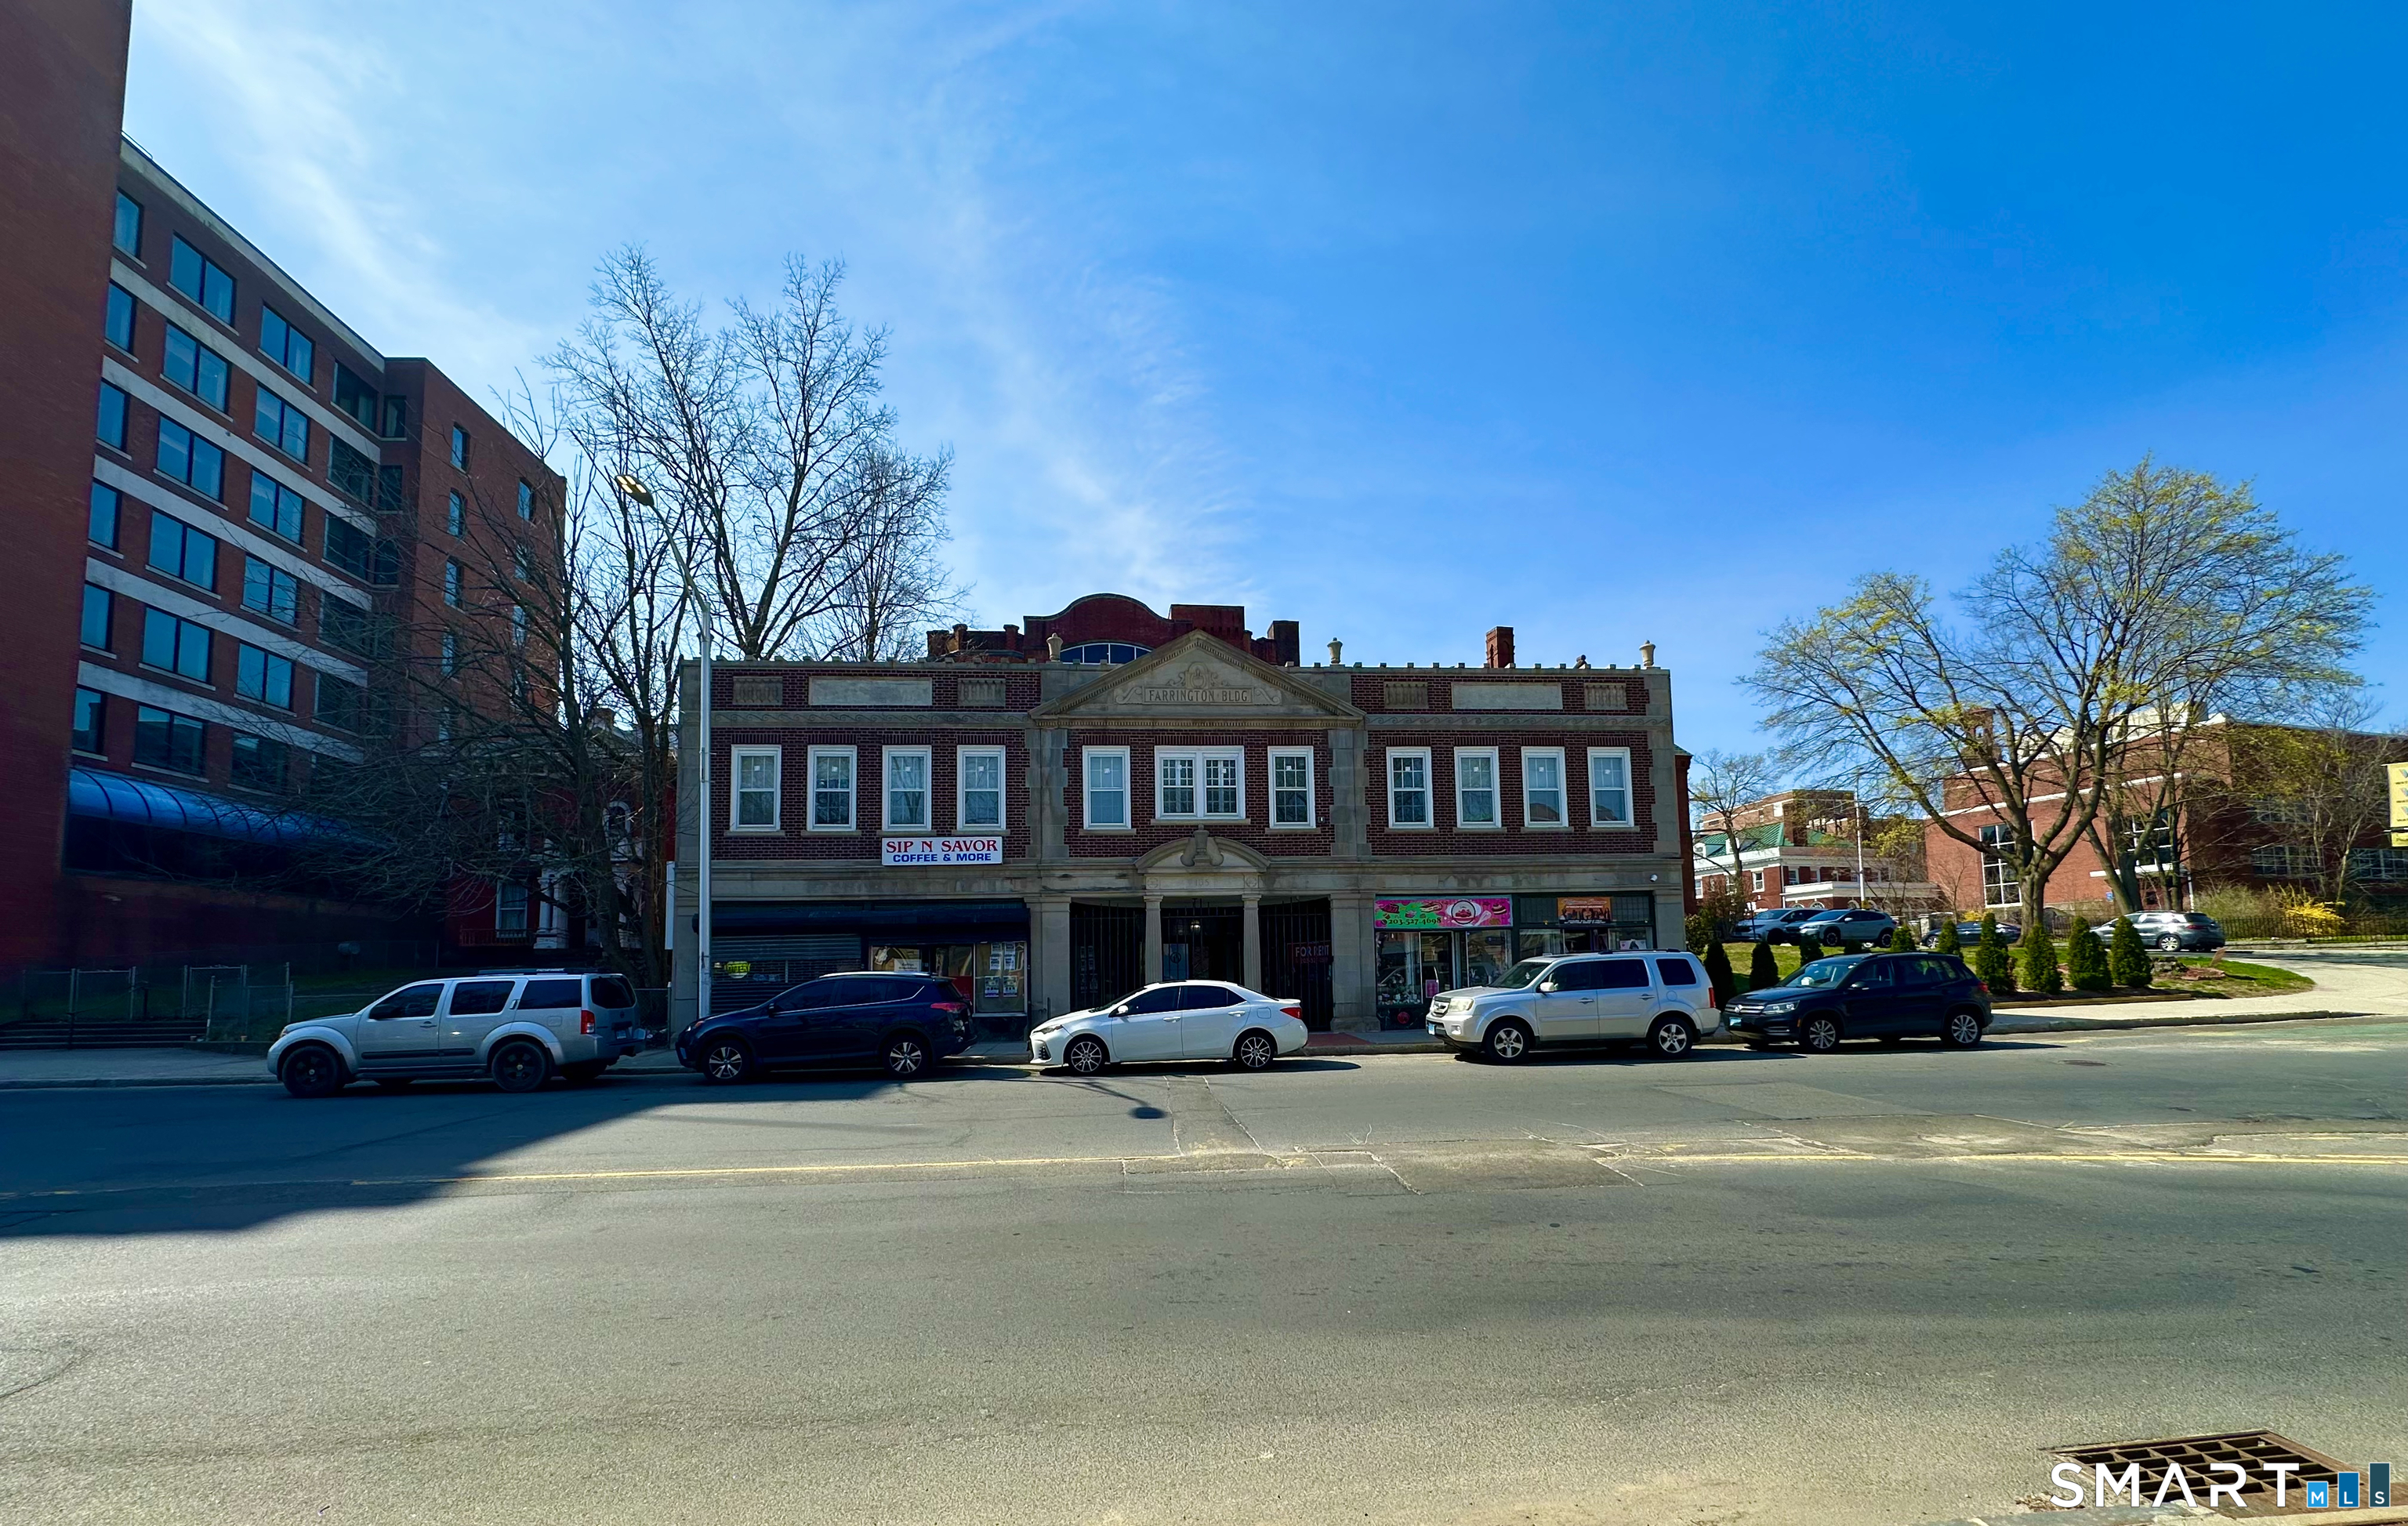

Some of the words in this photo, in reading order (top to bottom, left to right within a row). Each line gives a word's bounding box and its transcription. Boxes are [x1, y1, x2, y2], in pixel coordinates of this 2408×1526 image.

[1149, 690, 1214, 701] FARRINGTON
[1222, 690, 1248, 701] BLDG
[886, 841, 913, 853] SIP
[921, 841, 933, 853] N
[941, 839, 998, 852] SAVOR
[893, 854, 937, 862] COFFEE
[956, 853, 992, 861] MORE
[1295, 946, 1312, 957] FOR
[1314, 944, 1329, 956] RENT
